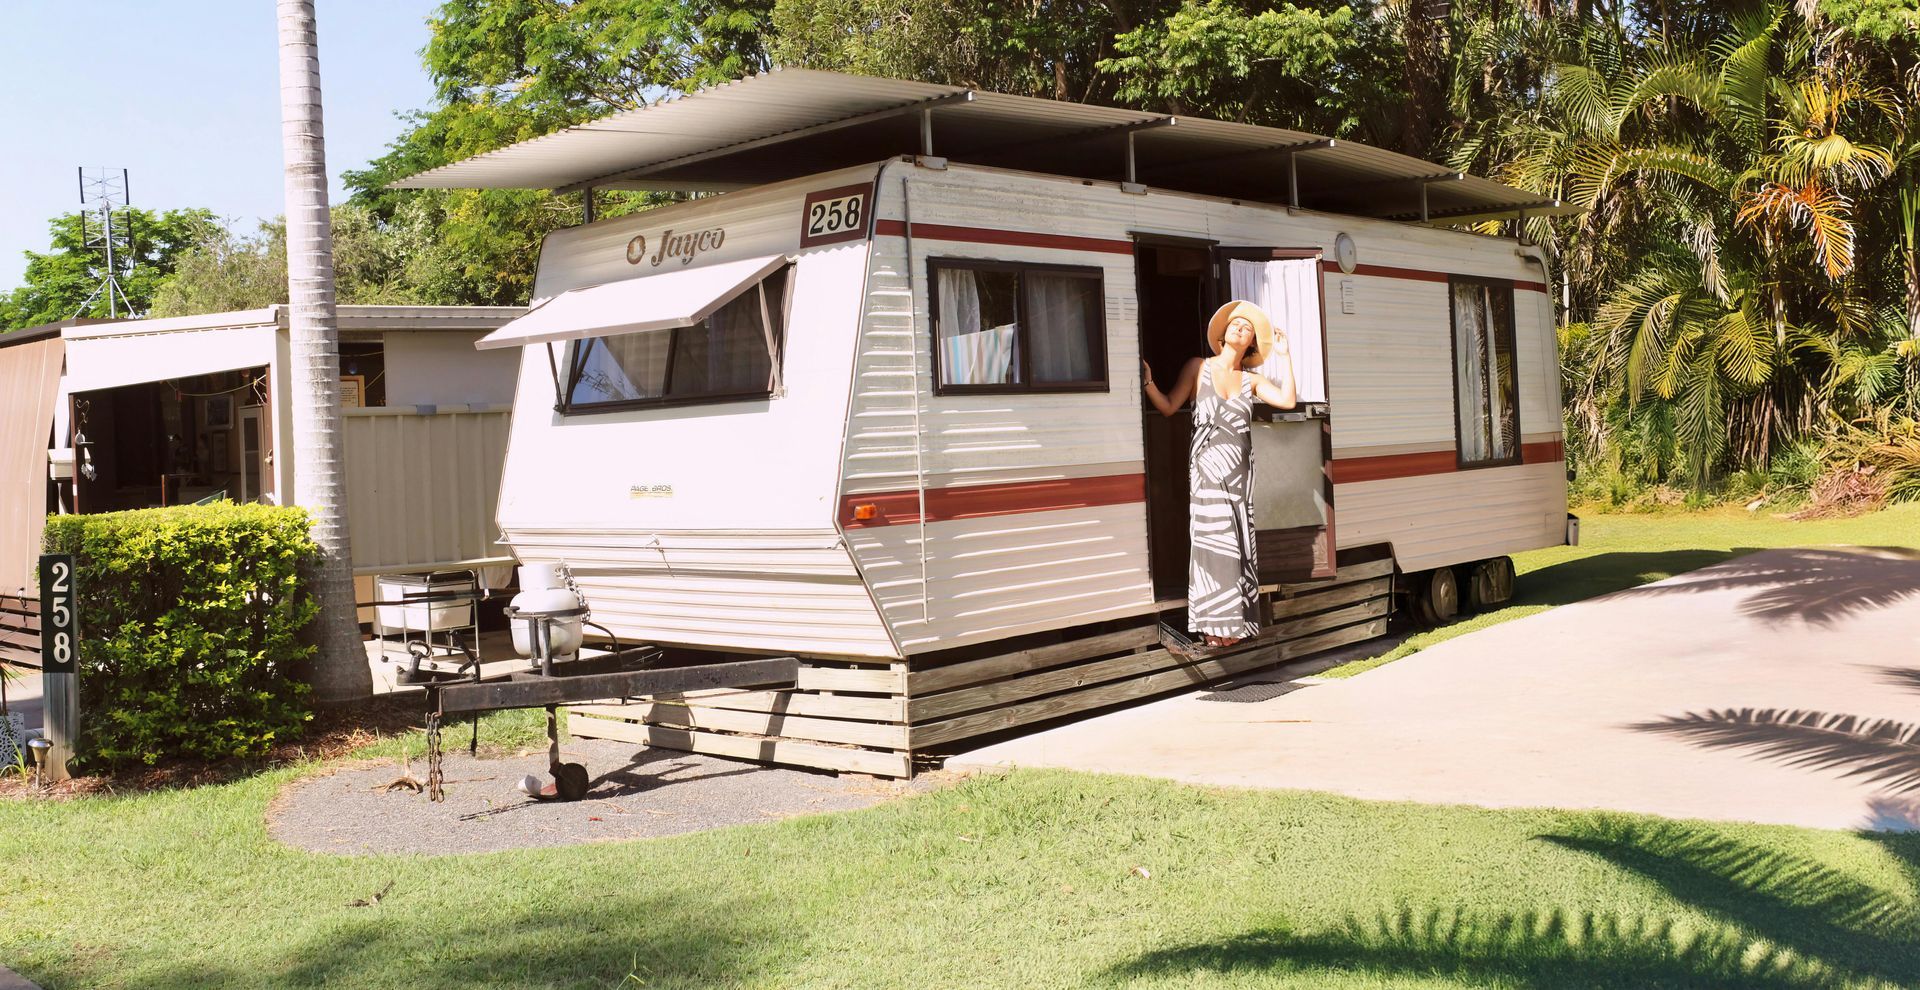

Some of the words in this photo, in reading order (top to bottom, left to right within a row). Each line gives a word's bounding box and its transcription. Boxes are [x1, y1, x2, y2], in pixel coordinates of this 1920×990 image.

[809, 197, 861, 235] 258
[650, 228, 725, 267] Jayco
[51, 561, 72, 664] 258
